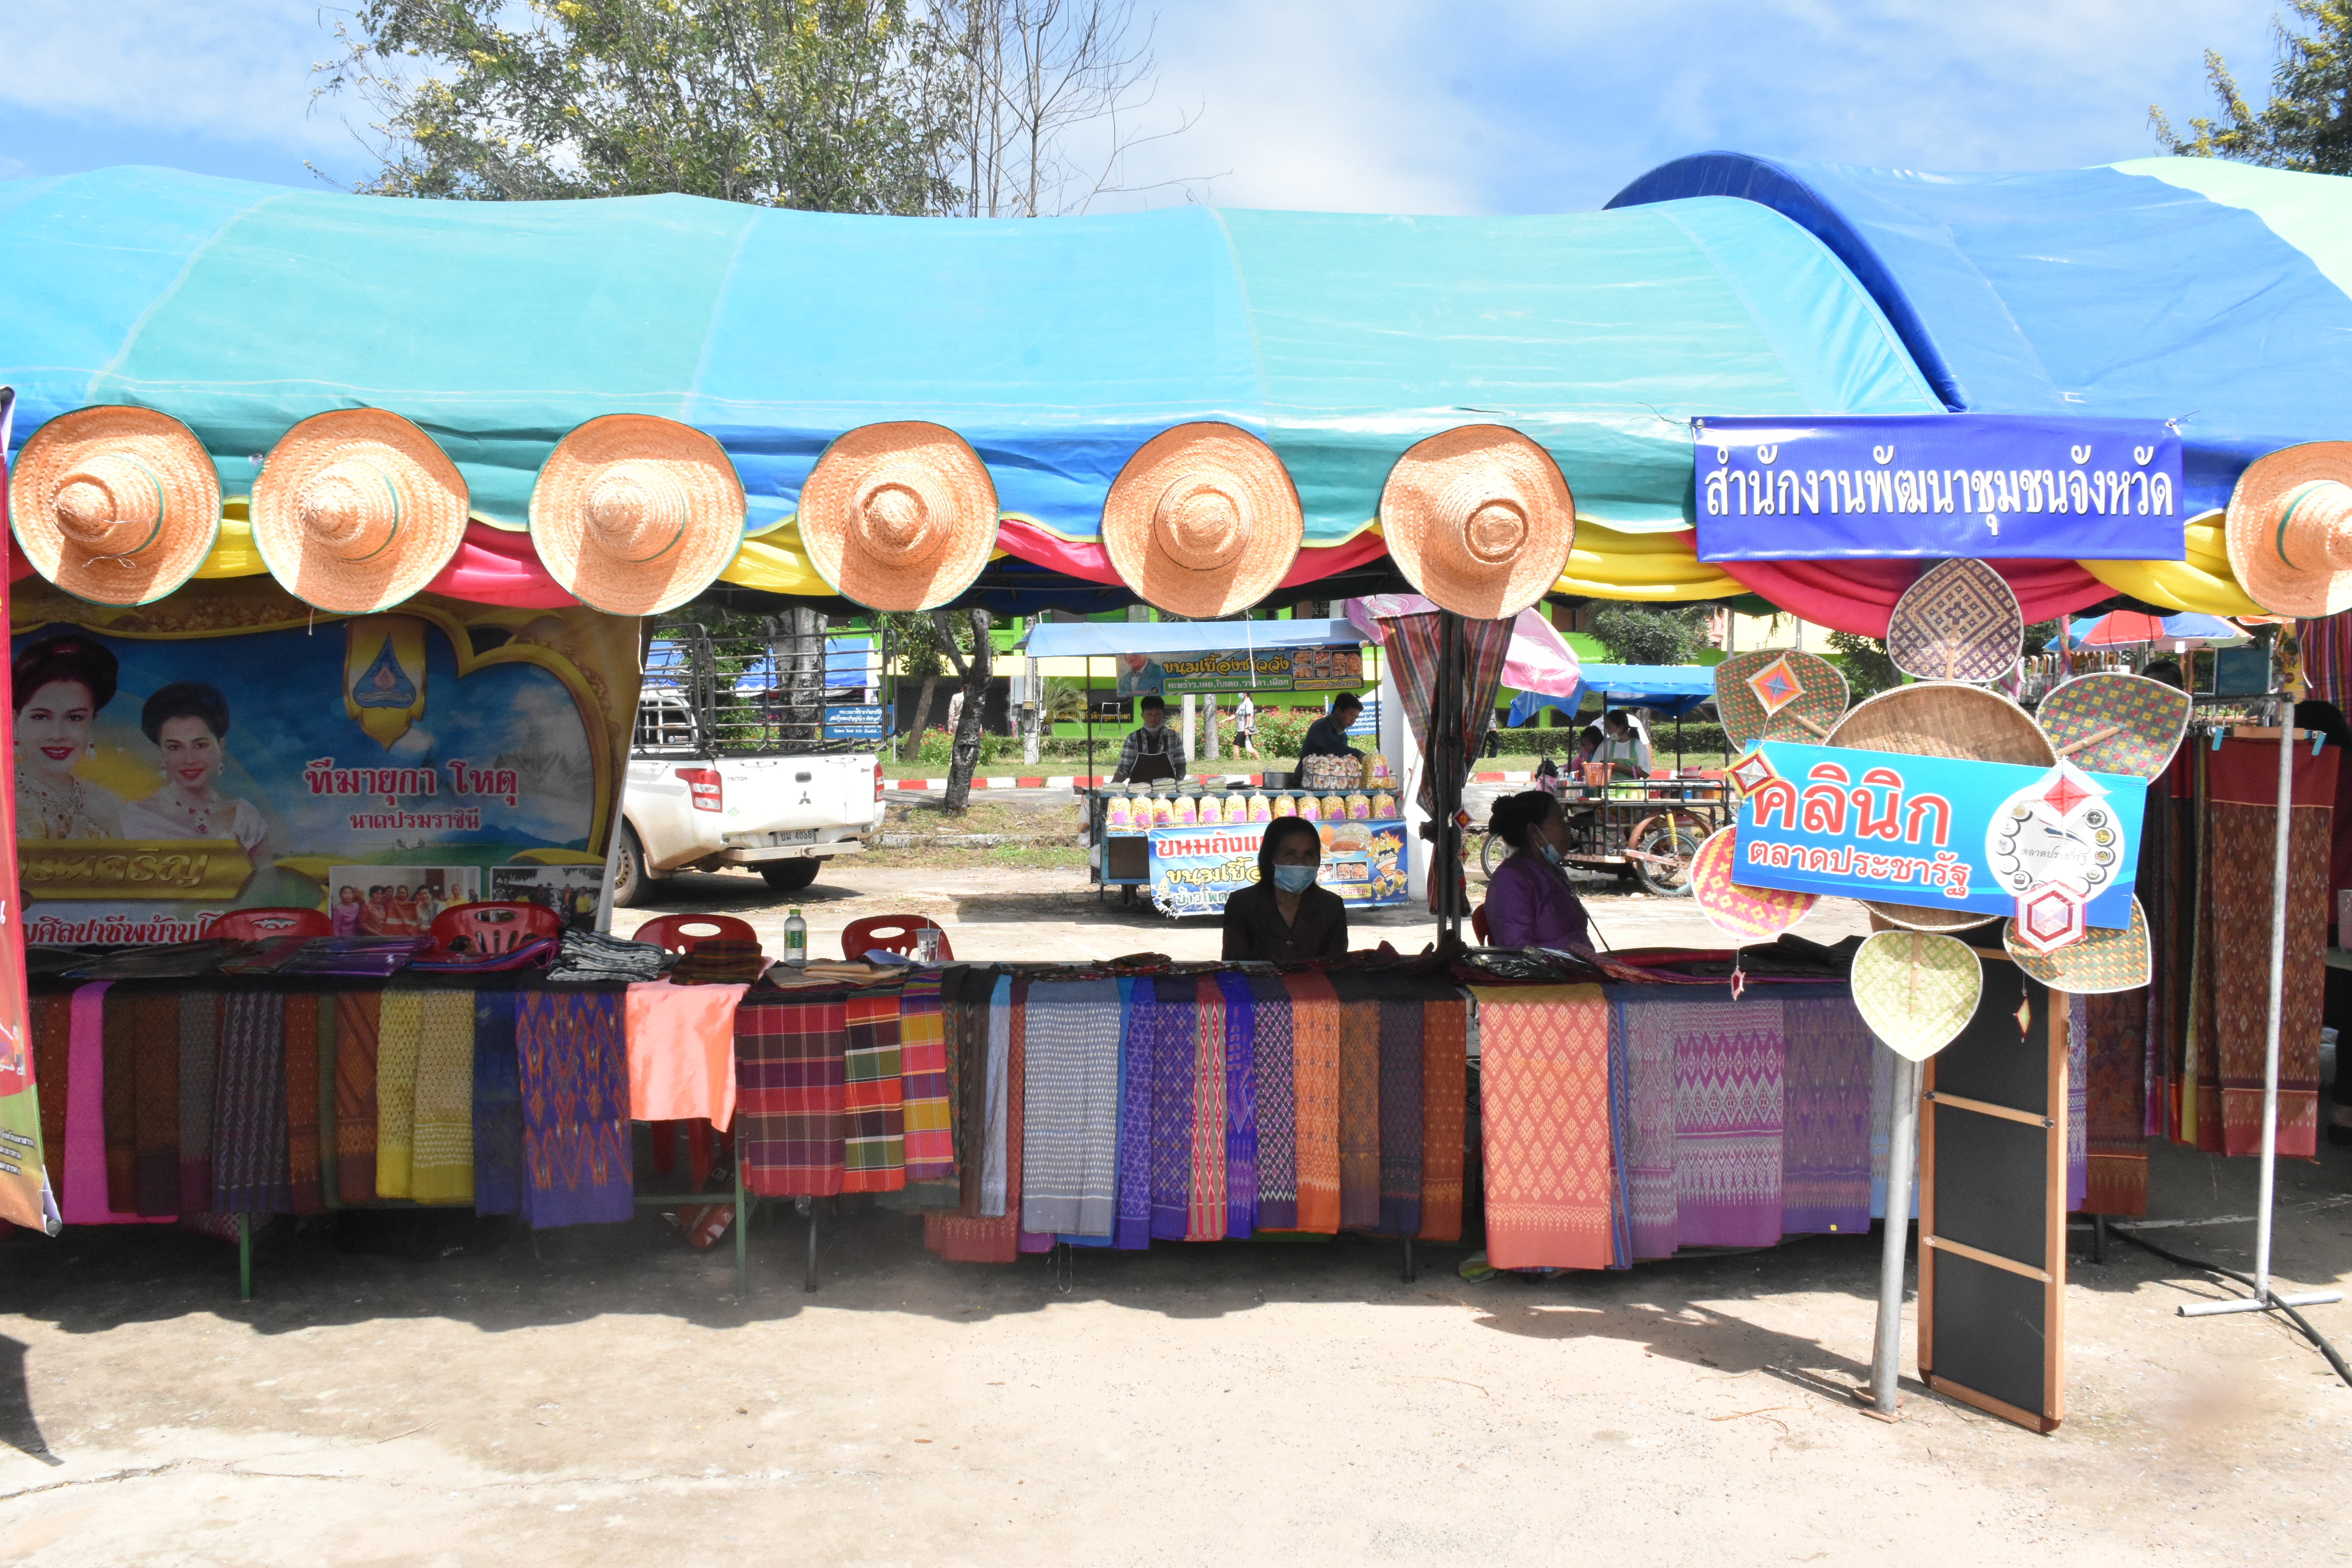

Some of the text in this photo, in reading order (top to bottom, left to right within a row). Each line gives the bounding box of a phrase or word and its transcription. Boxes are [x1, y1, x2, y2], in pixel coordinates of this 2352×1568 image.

[1705, 445, 2174, 536] สำนักงานพัฒนาชุมชนจังหวัด
[304, 758, 519, 806] ทีฆายุกา โหตุ
[1751, 762, 1952, 848] คลินิก
[19, 848, 209, 888] ระเจริญ
[1158, 831, 1264, 857] ขนมถังแ
[2022, 846, 2087, 866] ตลาดประชารัฐ
[1748, 838, 1971, 900] ตลาดประชารัฐ
